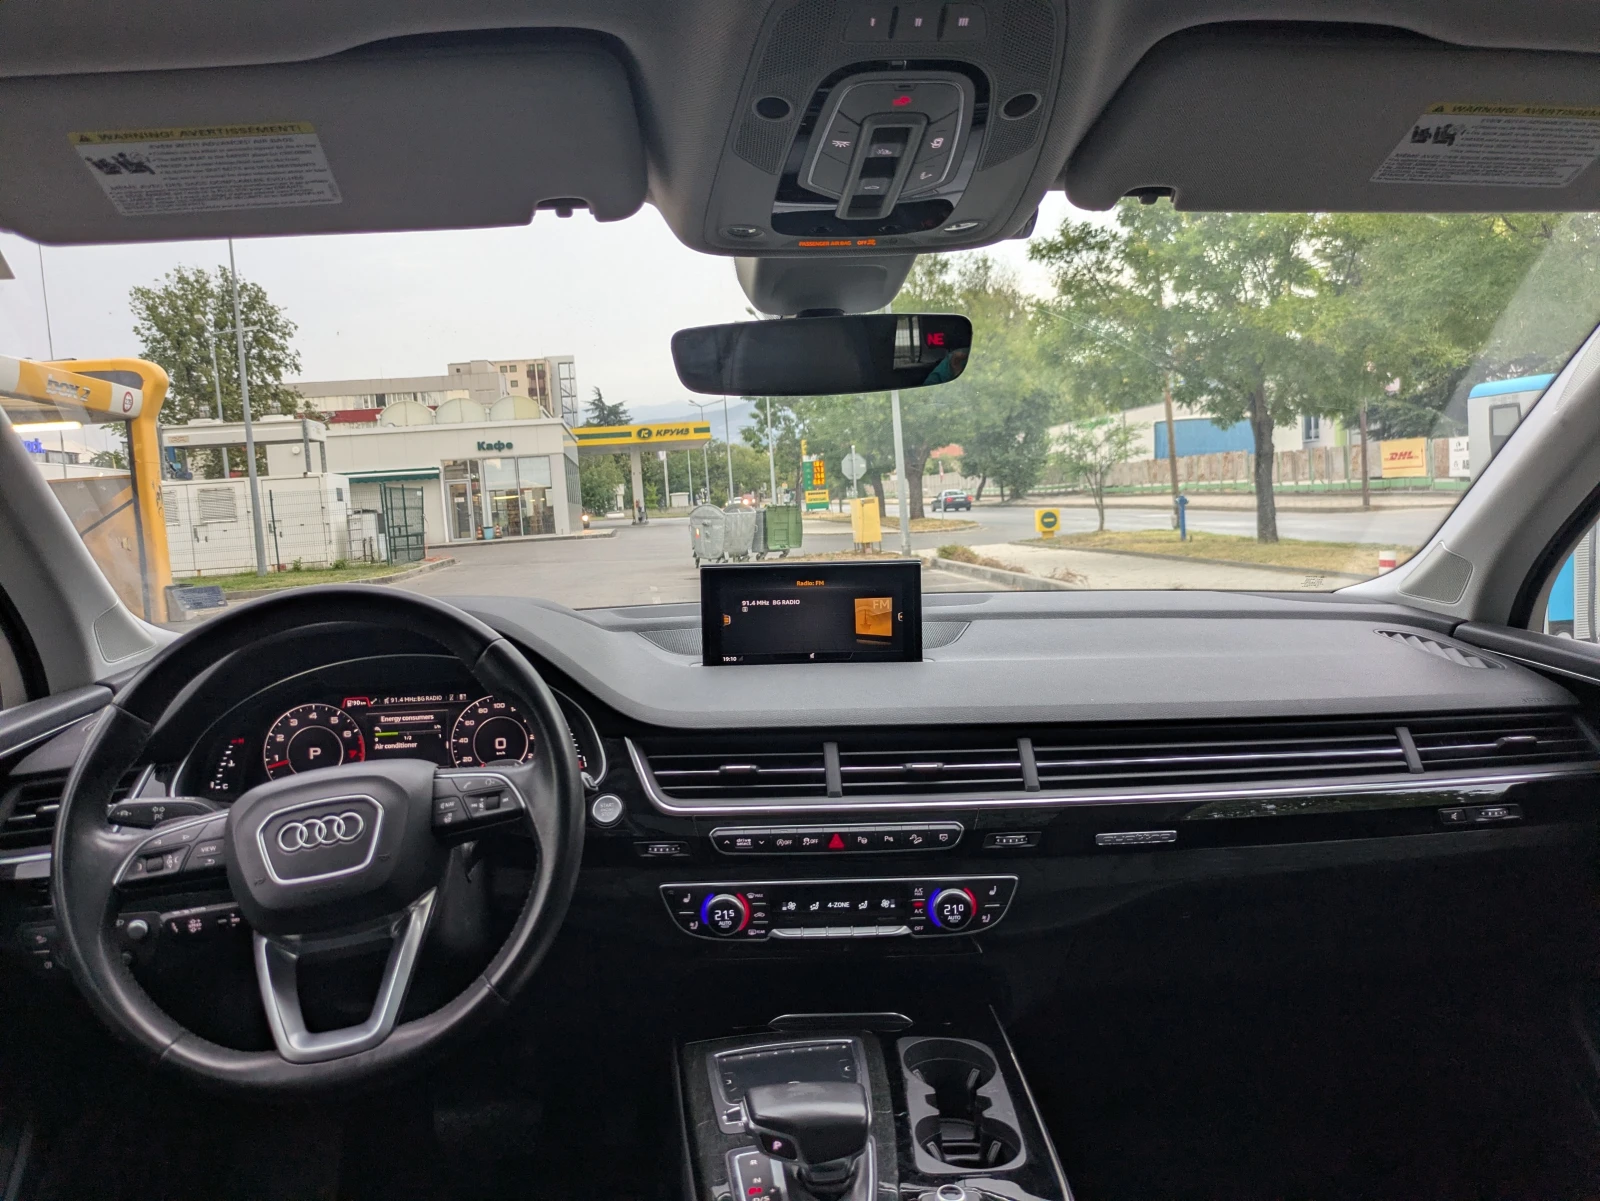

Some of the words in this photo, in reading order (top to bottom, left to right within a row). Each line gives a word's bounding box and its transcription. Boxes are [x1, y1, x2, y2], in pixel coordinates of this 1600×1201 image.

[98, 131, 174, 140] WARNING!
[180, 125, 302, 138] AVERTISSEMENT!
[928, 332, 944, 346] NE
[80, 386, 91, 402] 2
[655, 428, 690, 437] КРУИЗ
[477, 440, 514, 452] Кафе
[1389, 450, 1414, 460] DHL
[873, 600, 890, 609] FM
[495, 738, 506, 749] 0
[309, 748, 321, 760] P
[772, 1140, 782, 1150] P
